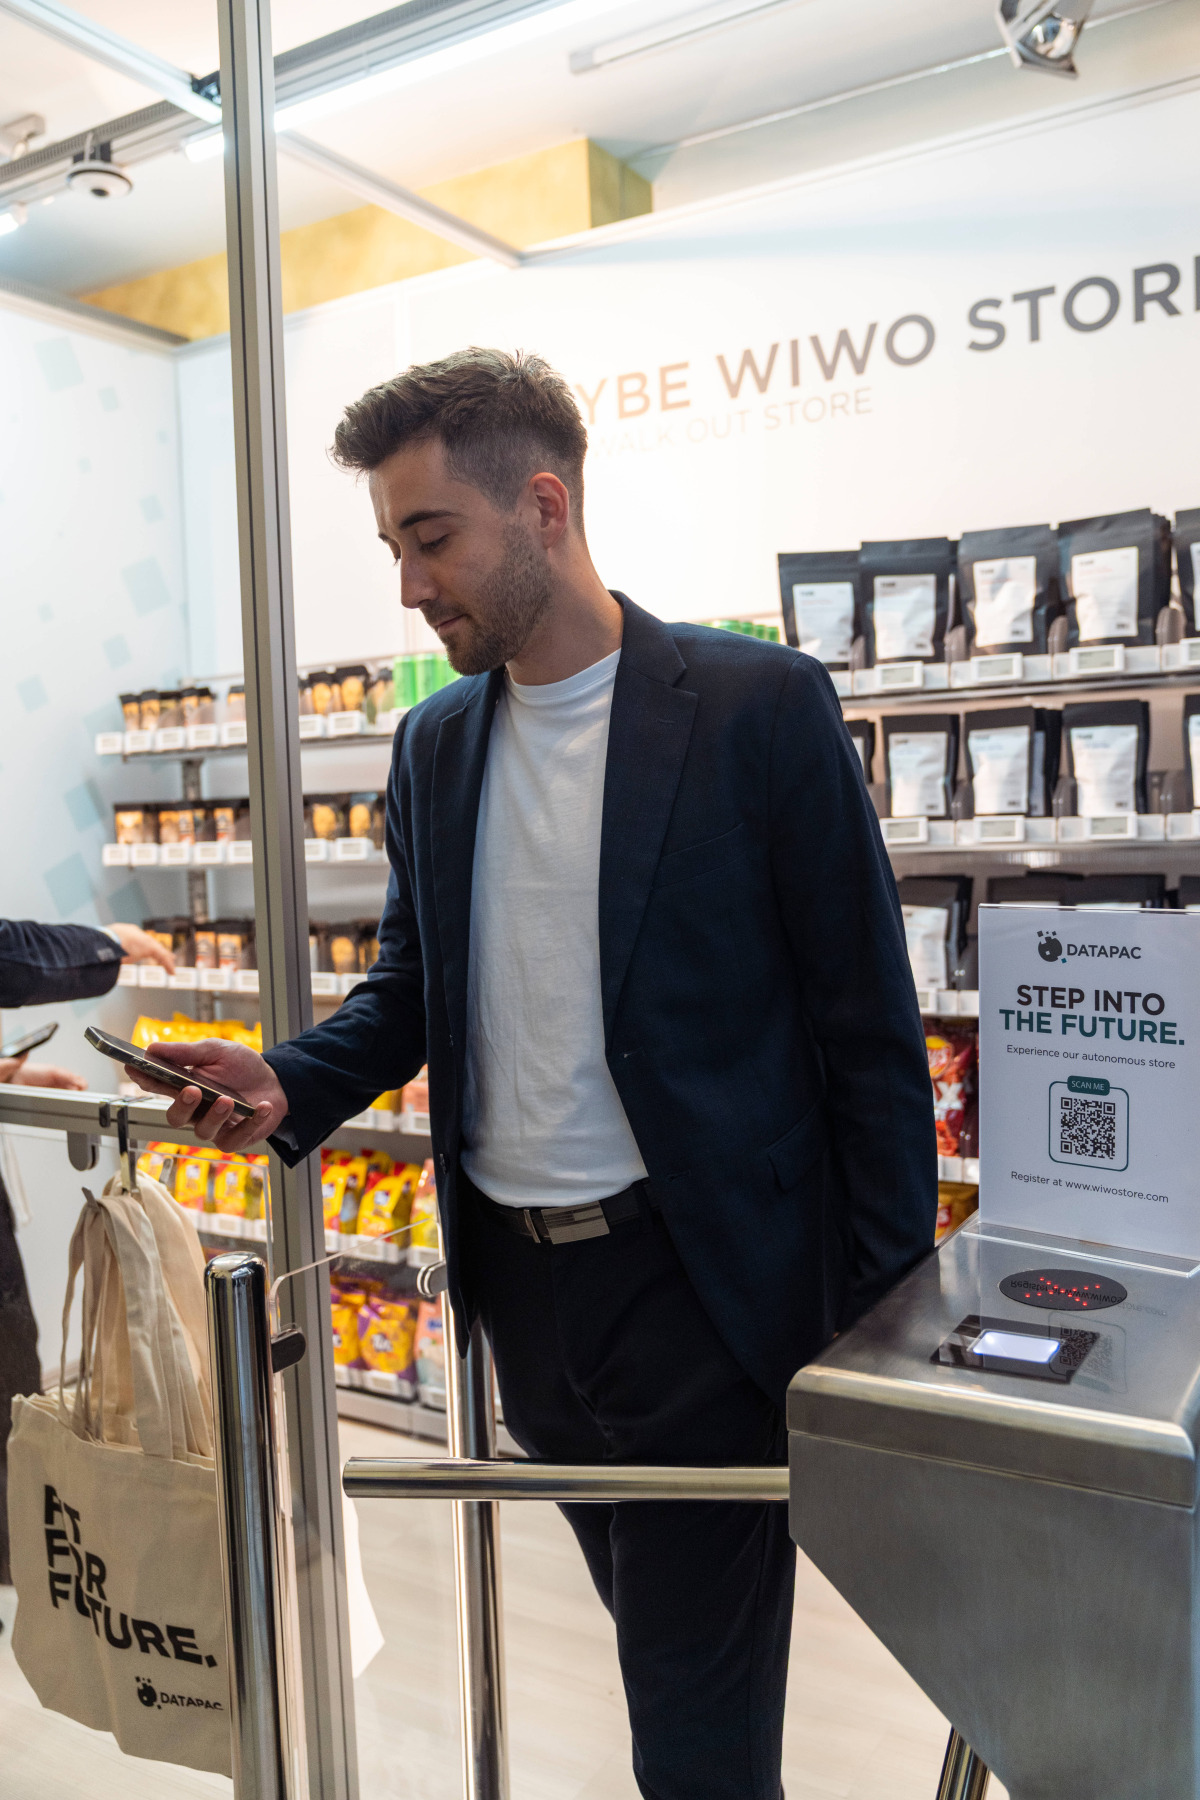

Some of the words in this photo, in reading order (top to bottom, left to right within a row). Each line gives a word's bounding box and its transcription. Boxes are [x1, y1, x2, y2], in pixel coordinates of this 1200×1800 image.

[716, 313, 936, 400] WIWO
[966, 254, 1200, 352] STOR
[685, 408, 752, 443] OUT
[763, 386, 873, 431] STORE
[1066, 943, 1142, 960] DATAPAC
[1016, 984, 1085, 1010] STEP
[1094, 989, 1166, 1016] INTO
[998, 1008, 1052, 1034] THE
[1061, 1013, 1185, 1046] FUTURE.
[1006, 1044, 1060, 1059] Experience
[1062, 1051, 1080, 1060] our
[1081, 1052, 1146, 1067] autonomous
[1148, 1058, 1176, 1069] store
[1071, 1080, 1092, 1089] SCAN
[1093, 1083, 1105, 1091] ME
[1010, 1170, 1050, 1185] Register
[1052, 1178, 1063, 1187] at
[1065, 1180, 1169, 1203] www.wiwostore.com
[159, 1691, 225, 1711] DATAPAC
